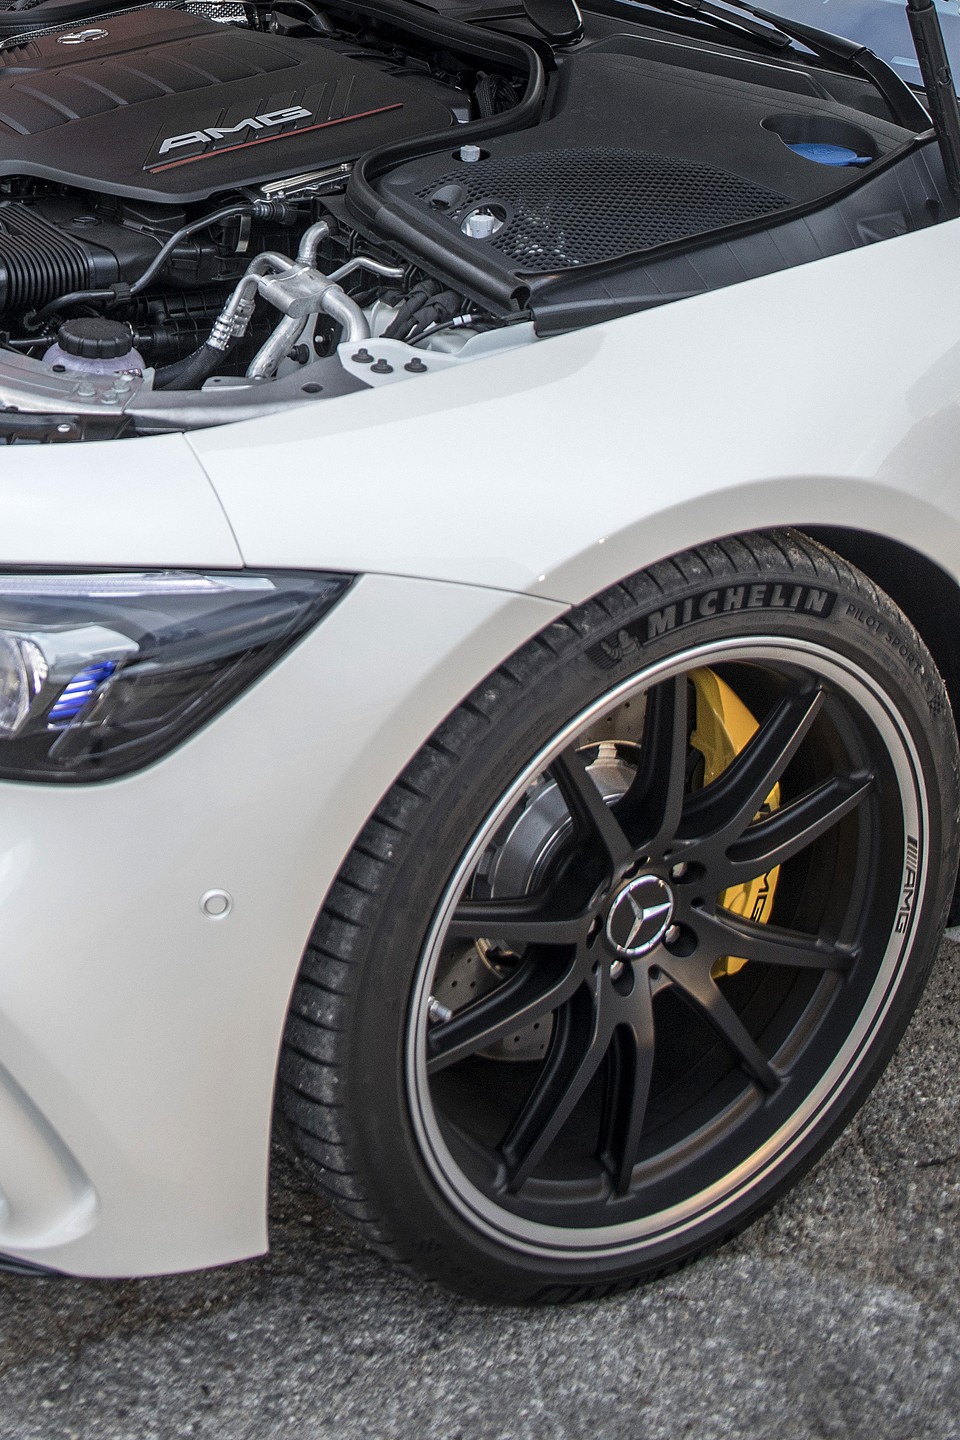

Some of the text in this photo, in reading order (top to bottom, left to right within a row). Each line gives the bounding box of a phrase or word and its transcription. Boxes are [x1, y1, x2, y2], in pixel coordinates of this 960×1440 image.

[158, 105, 313, 155] AMG
[646, 584, 830, 640] MICHELIN
[845, 603, 922, 675] PILOT SPORT
[895, 866, 917, 934] AMG
